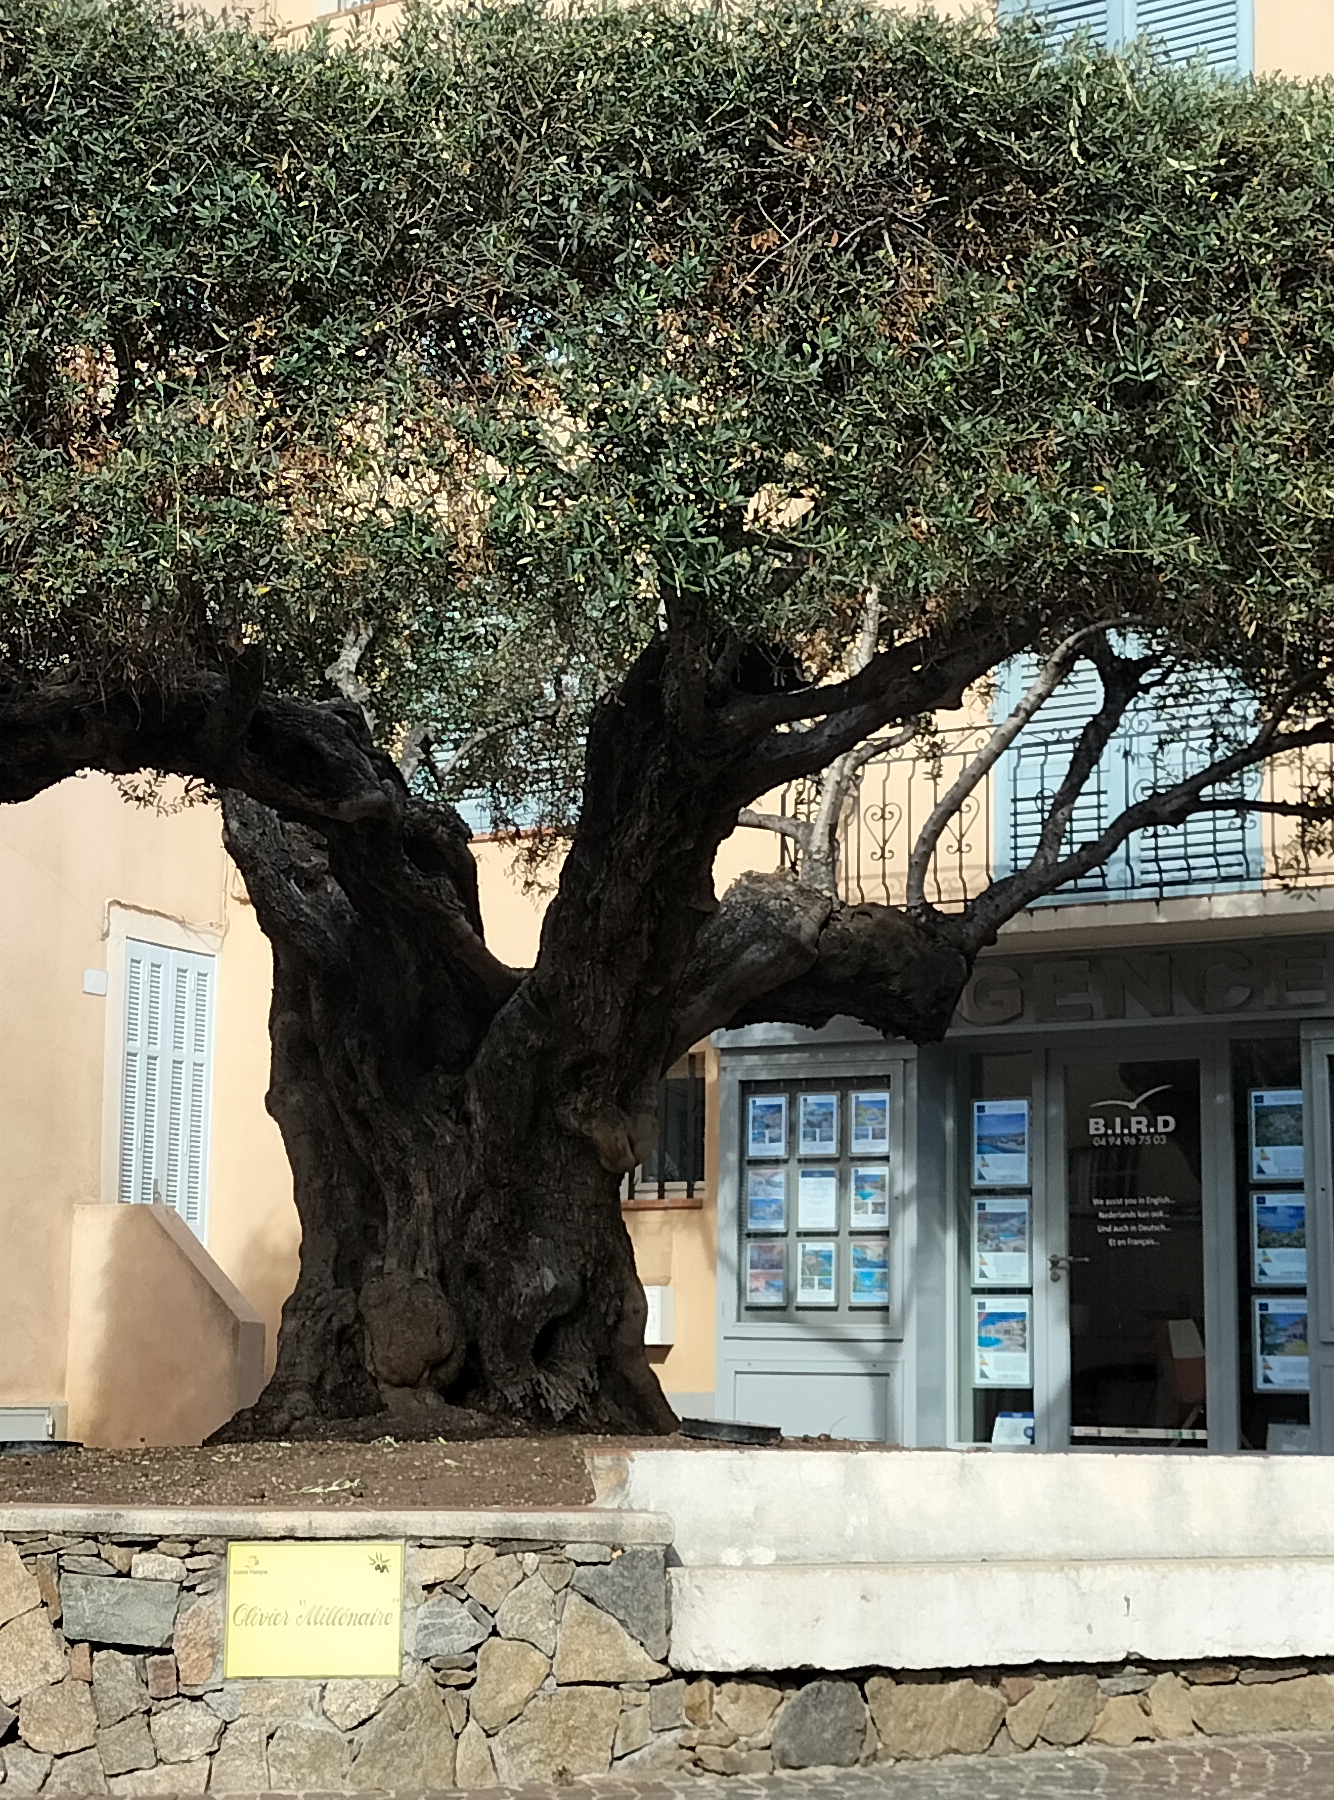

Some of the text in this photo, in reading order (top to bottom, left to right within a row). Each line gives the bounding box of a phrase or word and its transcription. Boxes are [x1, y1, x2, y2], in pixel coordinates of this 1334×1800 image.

[957, 942, 1328, 1026] GENCE
[1089, 1115, 1176, 1134] B.I.R.D
[233, 1603, 290, 1627] Olivier
